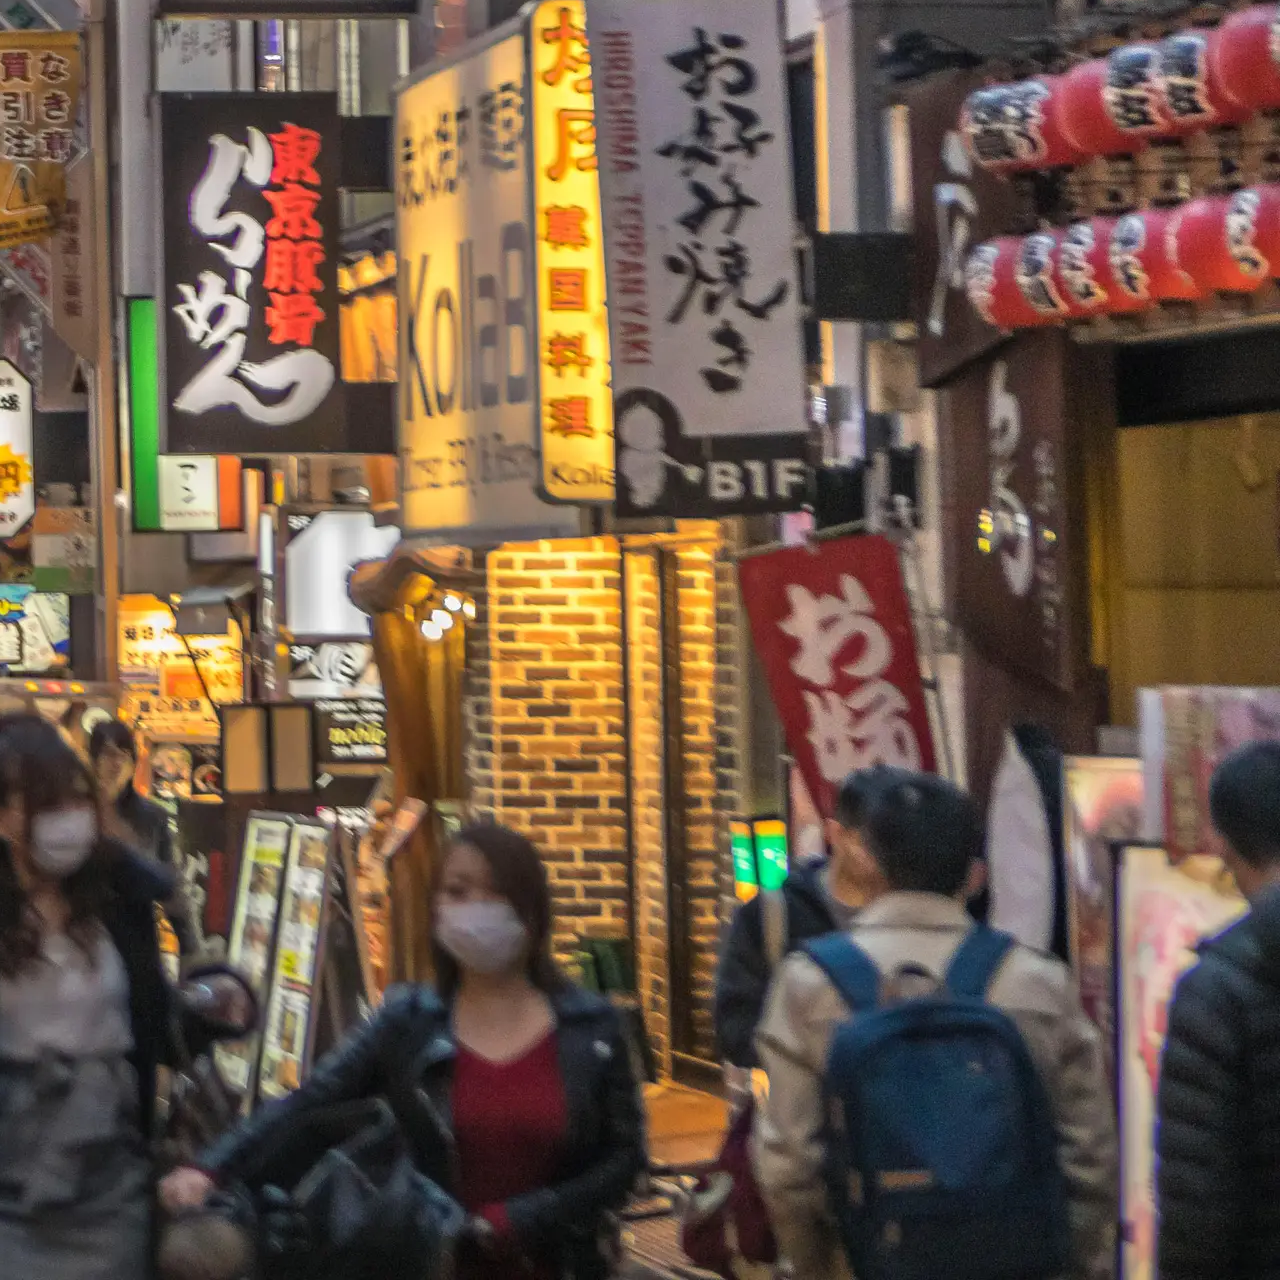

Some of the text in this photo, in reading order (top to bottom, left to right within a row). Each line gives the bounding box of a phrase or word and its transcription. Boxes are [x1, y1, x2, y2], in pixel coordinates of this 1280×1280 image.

[601, 30, 638, 175] HIROSHIMA
[657, 26, 789, 394] お好み焼き
[172, 126, 335, 423] らーめん
[545, 203, 595, 440] 韓国料理
[707, 458, 807, 502] B1F
